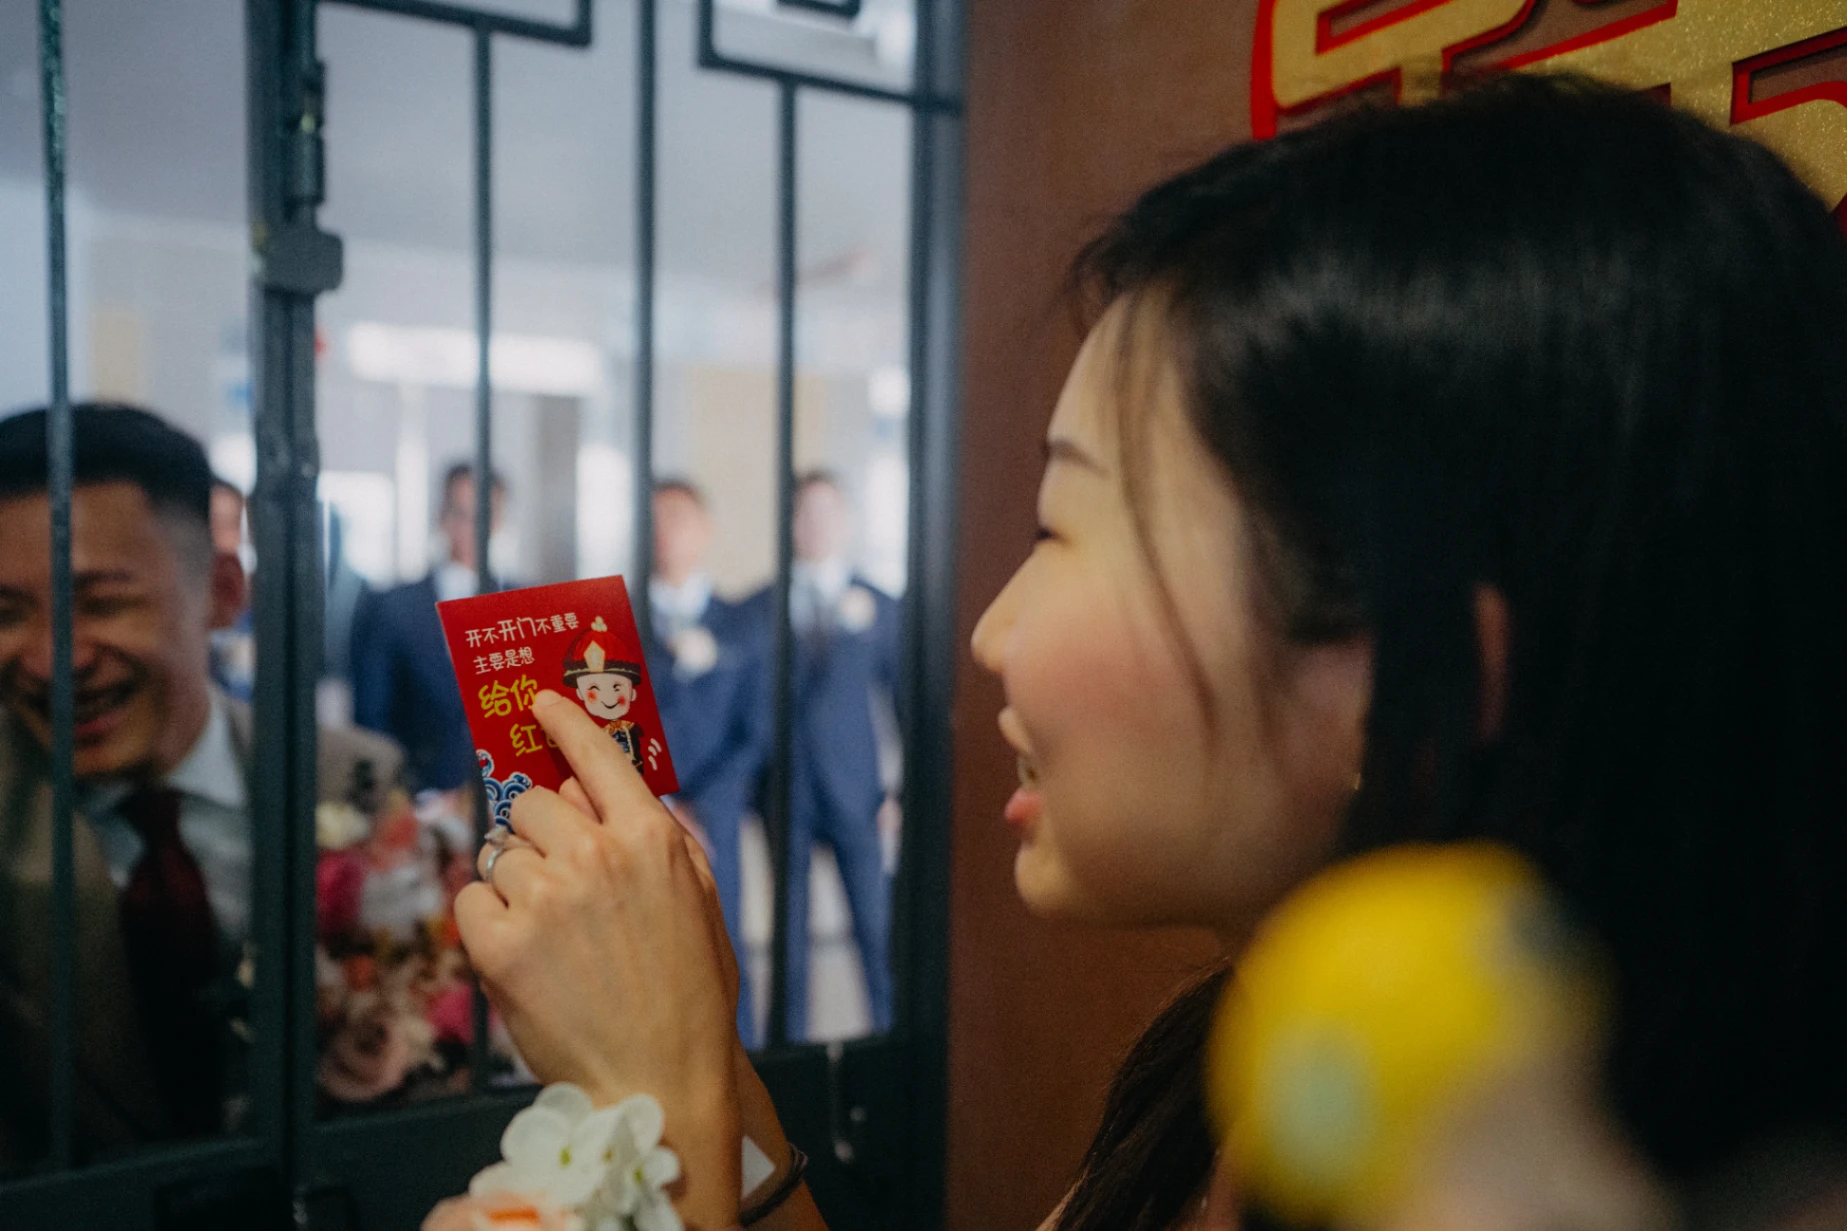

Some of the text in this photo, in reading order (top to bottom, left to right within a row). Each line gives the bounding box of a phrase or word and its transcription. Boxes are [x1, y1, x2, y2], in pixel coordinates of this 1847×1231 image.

[465, 612, 579, 648] 开不开门不重要
[473, 646, 534, 675] 主要是想
[478, 675, 538, 718] 给你
[509, 723, 559, 757] 红
